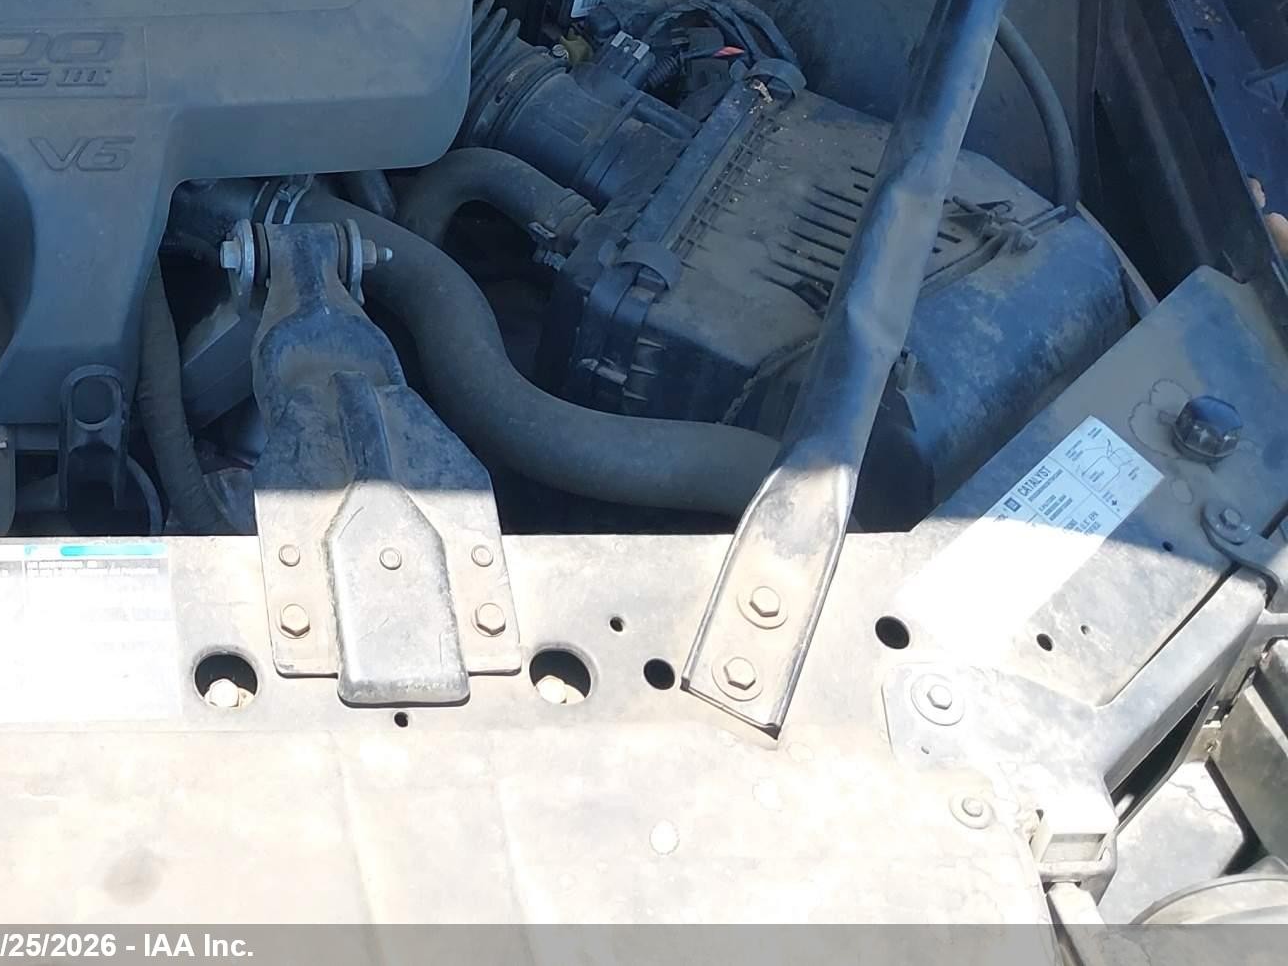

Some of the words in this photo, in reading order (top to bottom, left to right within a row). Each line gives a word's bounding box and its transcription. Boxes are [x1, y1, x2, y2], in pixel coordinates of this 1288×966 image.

[56, 68, 112, 87] III
[28, 135, 137, 172] V6
[1017, 465, 1051, 496] CATALYST
